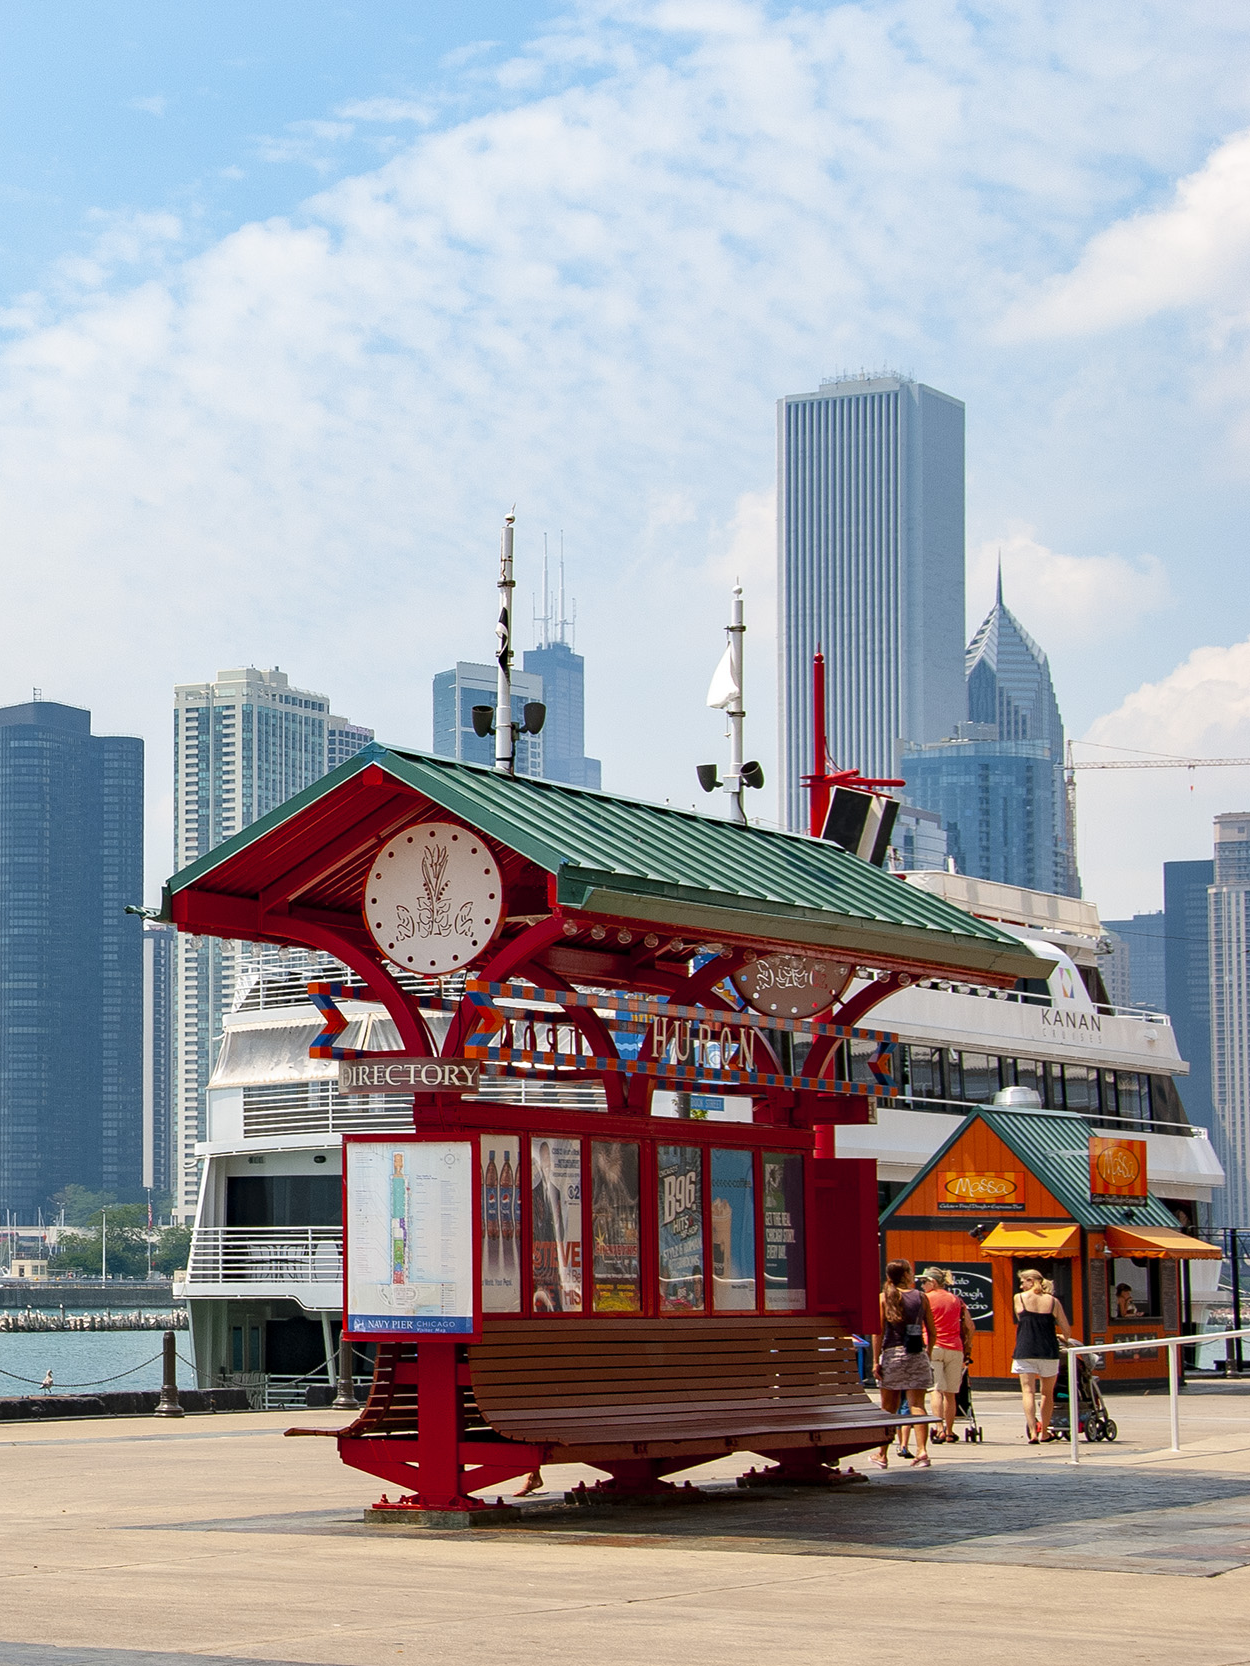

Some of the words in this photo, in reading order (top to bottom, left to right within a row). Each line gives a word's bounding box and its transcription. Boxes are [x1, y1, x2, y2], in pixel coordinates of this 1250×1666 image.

[1041, 1008, 1101, 1032] KANAN
[651, 1016, 755, 1069] HURON
[1043, 1028, 1102, 1044] CRUISES
[342, 1064, 478, 1087] DIRECTORY
[955, 1178, 1009, 1197] Massa
[673, 1216, 689, 1234] HITS
[533, 1241, 581, 1268] STEVE
[952, 1275, 969, 1285] lato
[952, 1287, 984, 1300] Dough
[368, 1319, 390, 1329] NAVY
[391, 1320, 413, 1329] PIER
